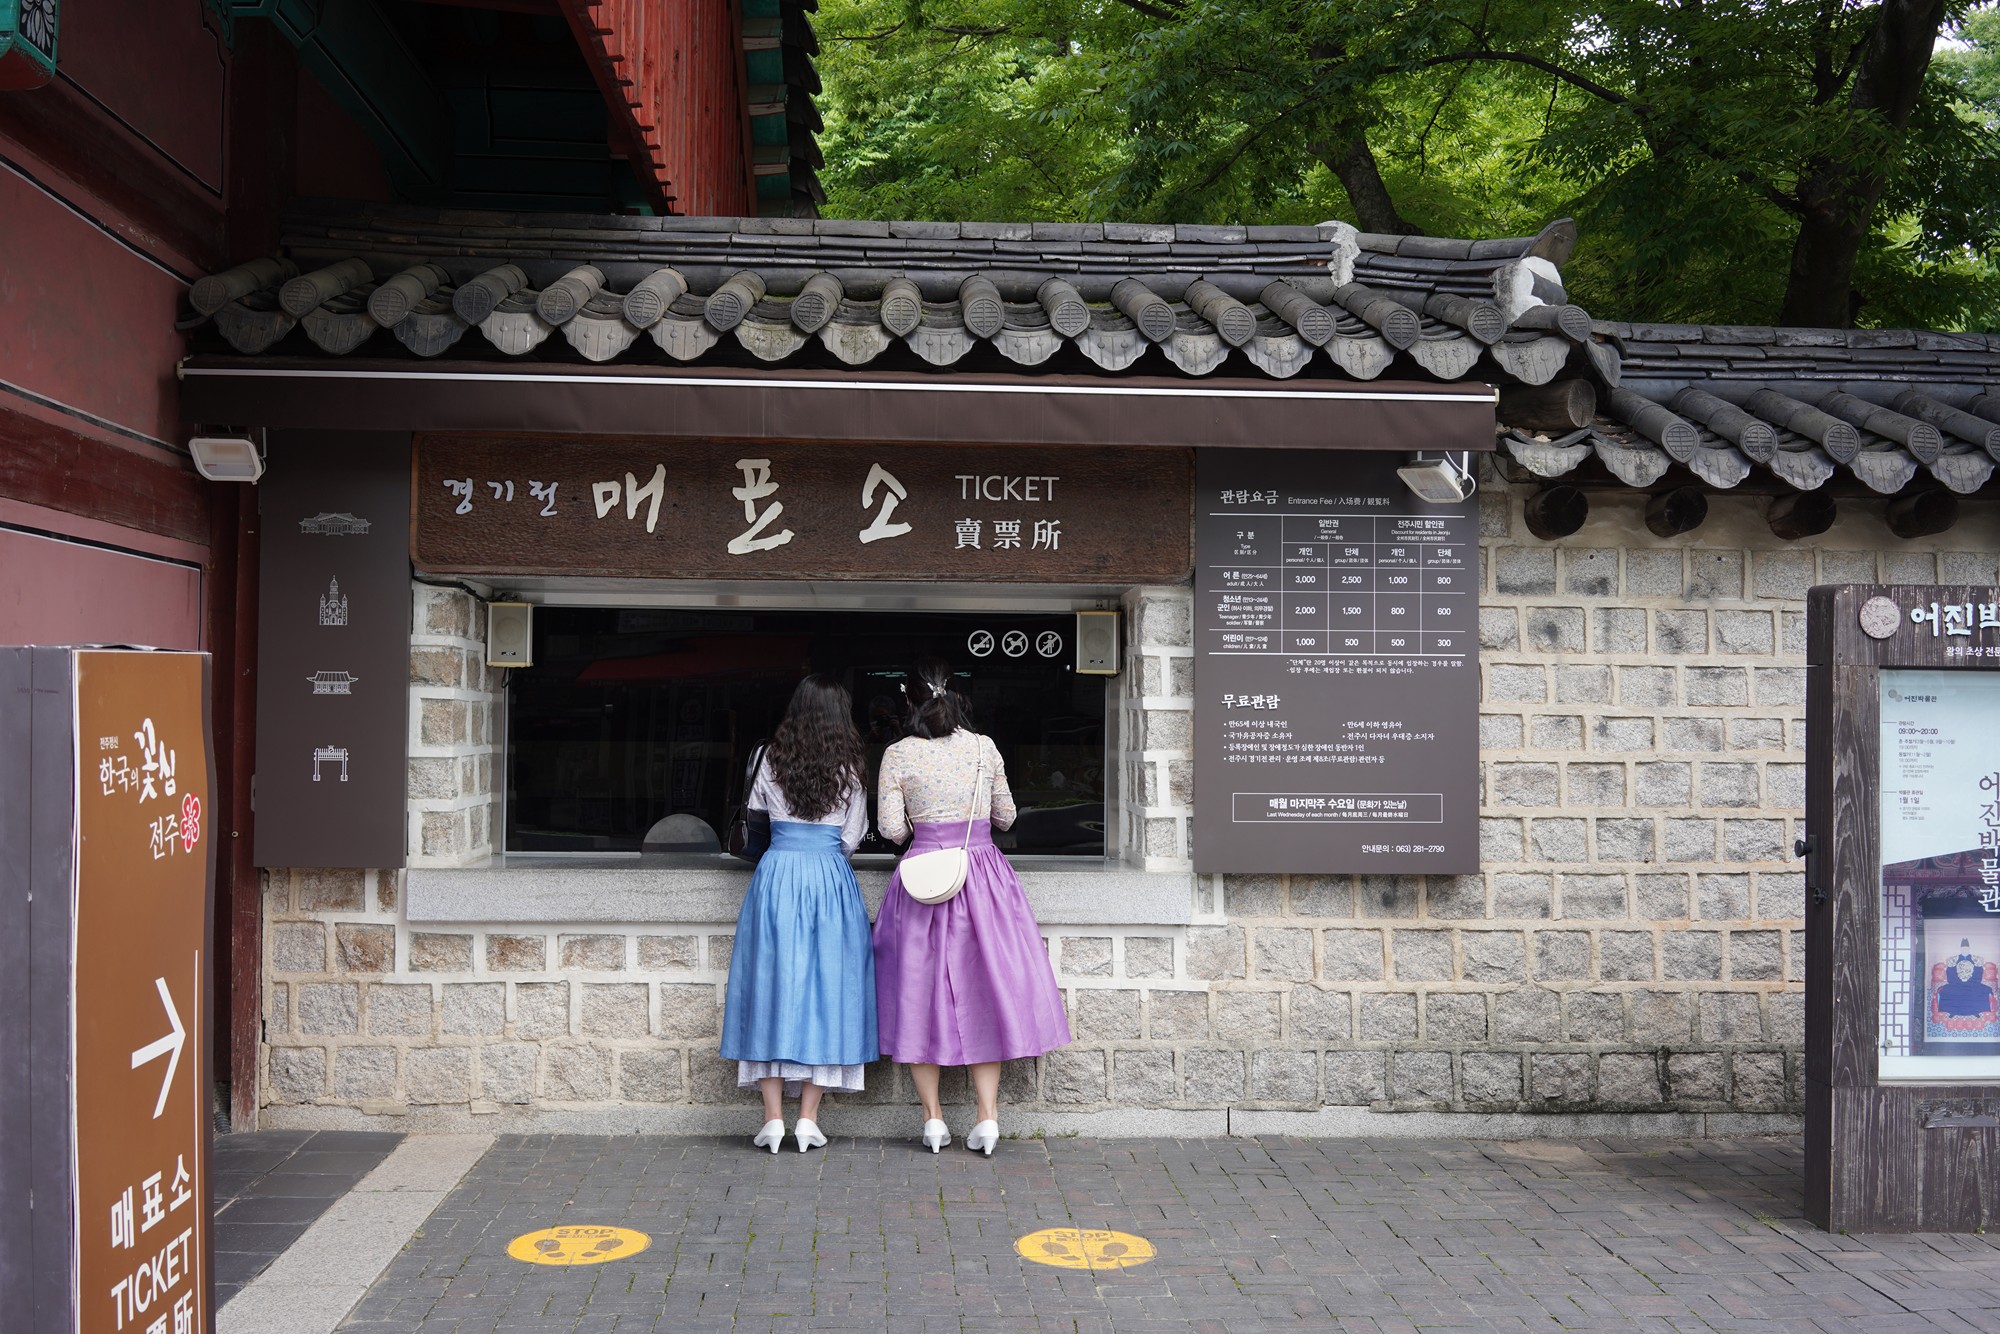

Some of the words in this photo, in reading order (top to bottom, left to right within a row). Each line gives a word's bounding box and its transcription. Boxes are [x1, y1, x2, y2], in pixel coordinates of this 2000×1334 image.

[954, 475, 1060, 502] TICKET
[1220, 489, 1279, 505] 관람요금
[1287, 497, 1318, 505] Entrance
[443, 477, 559, 517] 경기전
[592, 458, 913, 555] 매표소
[1318, 519, 1339, 528] 일반권
[1397, 520, 1423, 529] 전주시민
[1424, 520, 1445, 529] 할인권
[954, 517, 1062, 551] 賣票所
[1298, 547, 1313, 556] 개인
[1344, 548, 1359, 557] 단체
[1391, 548, 1405, 557] 개인
[1437, 548, 1452, 557] 단체
[1295, 575, 1316, 584] 3,000
[1341, 576, 1362, 585] 2,500
[1388, 576, 1408, 585] 1,000
[1437, 576, 1452, 585] 800
[1223, 595, 1242, 604] 청소년
[1217, 604, 1230, 612] 군인
[1295, 606, 1316, 615] 2,000
[1342, 607, 1362, 616] 1,500
[1391, 607, 1405, 616] 800
[1437, 608, 1452, 616] 600
[1222, 634, 1244, 643] 어린이
[1295, 638, 1316, 647] 1,000
[1344, 638, 1359, 647] 500
[1391, 638, 1405, 647] 500
[1437, 639, 1452, 647] 300
[1945, 646, 1963, 657] 왕의
[1965, 646, 1984, 657] 초상
[1221, 694, 1281, 710] 무료관람
[1904, 695, 1938, 703] 어진박물관
[1228, 720, 1250, 728] 만65세
[1251, 720, 1266, 728] 이상
[1266, 720, 1288, 728] 내국인
[1381, 721, 1403, 729] 영유아
[1346, 732, 1368, 740] 전주시
[1369, 732, 1390, 740] 다자녀
[1413, 733, 1435, 741] 소지자
[99, 735, 120, 751] 전주정신
[1228, 743, 1260, 751] 등록장애인
[1314, 744, 1335, 752] 장애인
[1335, 744, 1354, 752] 동반자
[99, 755, 139, 797] 한국의
[134, 717, 177, 805] 꽃심
[1228, 755, 1248, 763] 전주시
[1248, 755, 1268, 763] 경기전
[1268, 755, 1281, 763] 관리
[1286, 755, 1298, 763] 운영
[1269, 798, 1288, 809] 매월
[1290, 798, 1326, 809] 마지막주
[1327, 798, 1355, 810] 수요일
[1356, 800, 1381, 810] (문화가
[1910, 796, 1920, 804] 1일
[149, 813, 180, 861] 전주
[1361, 844, 1390, 853] 안내문의
[1395, 844, 1412, 853] 063)
[1412, 845, 1445, 853] 281-2790
[110, 1153, 193, 1250] 매표소
[1053, 1230, 1108, 1238] STOP
[110, 1226, 193, 1332] TICKET
